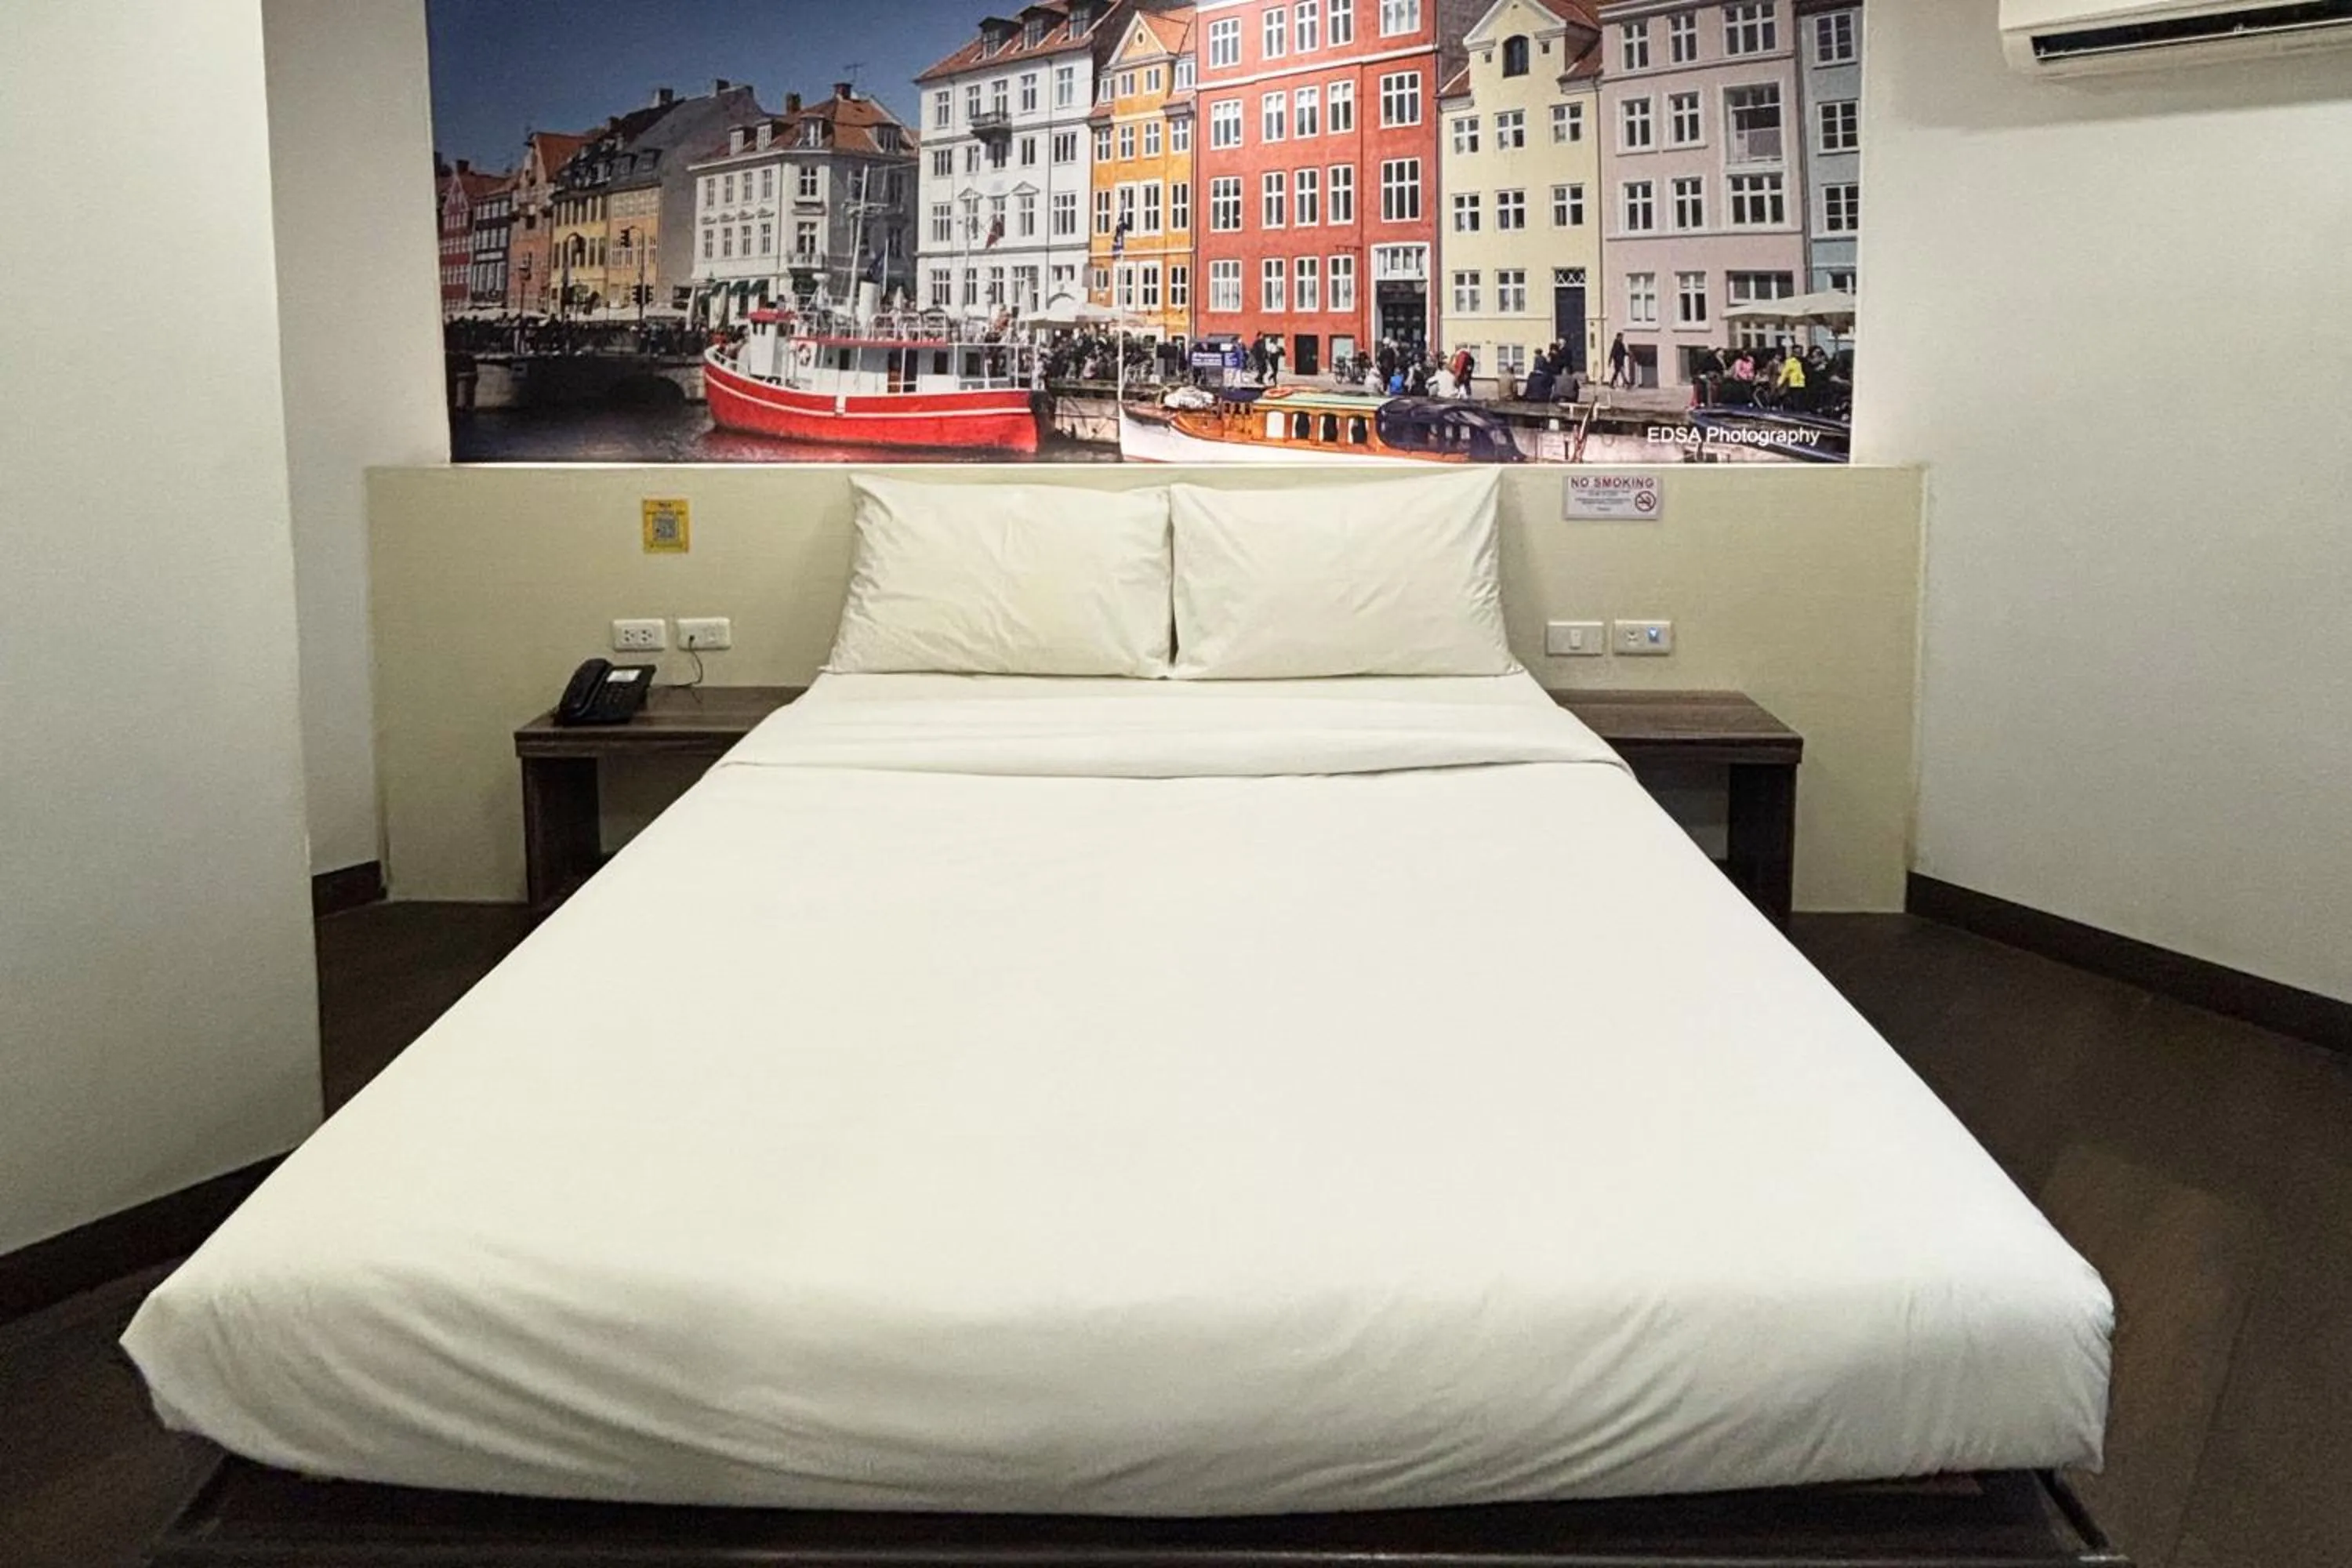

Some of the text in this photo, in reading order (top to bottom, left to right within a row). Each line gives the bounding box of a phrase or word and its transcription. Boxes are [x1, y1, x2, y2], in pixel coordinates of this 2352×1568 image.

[1647, 427, 1820, 446] EDSA Photography
[1571, 477, 1654, 487] NO SMOKING
